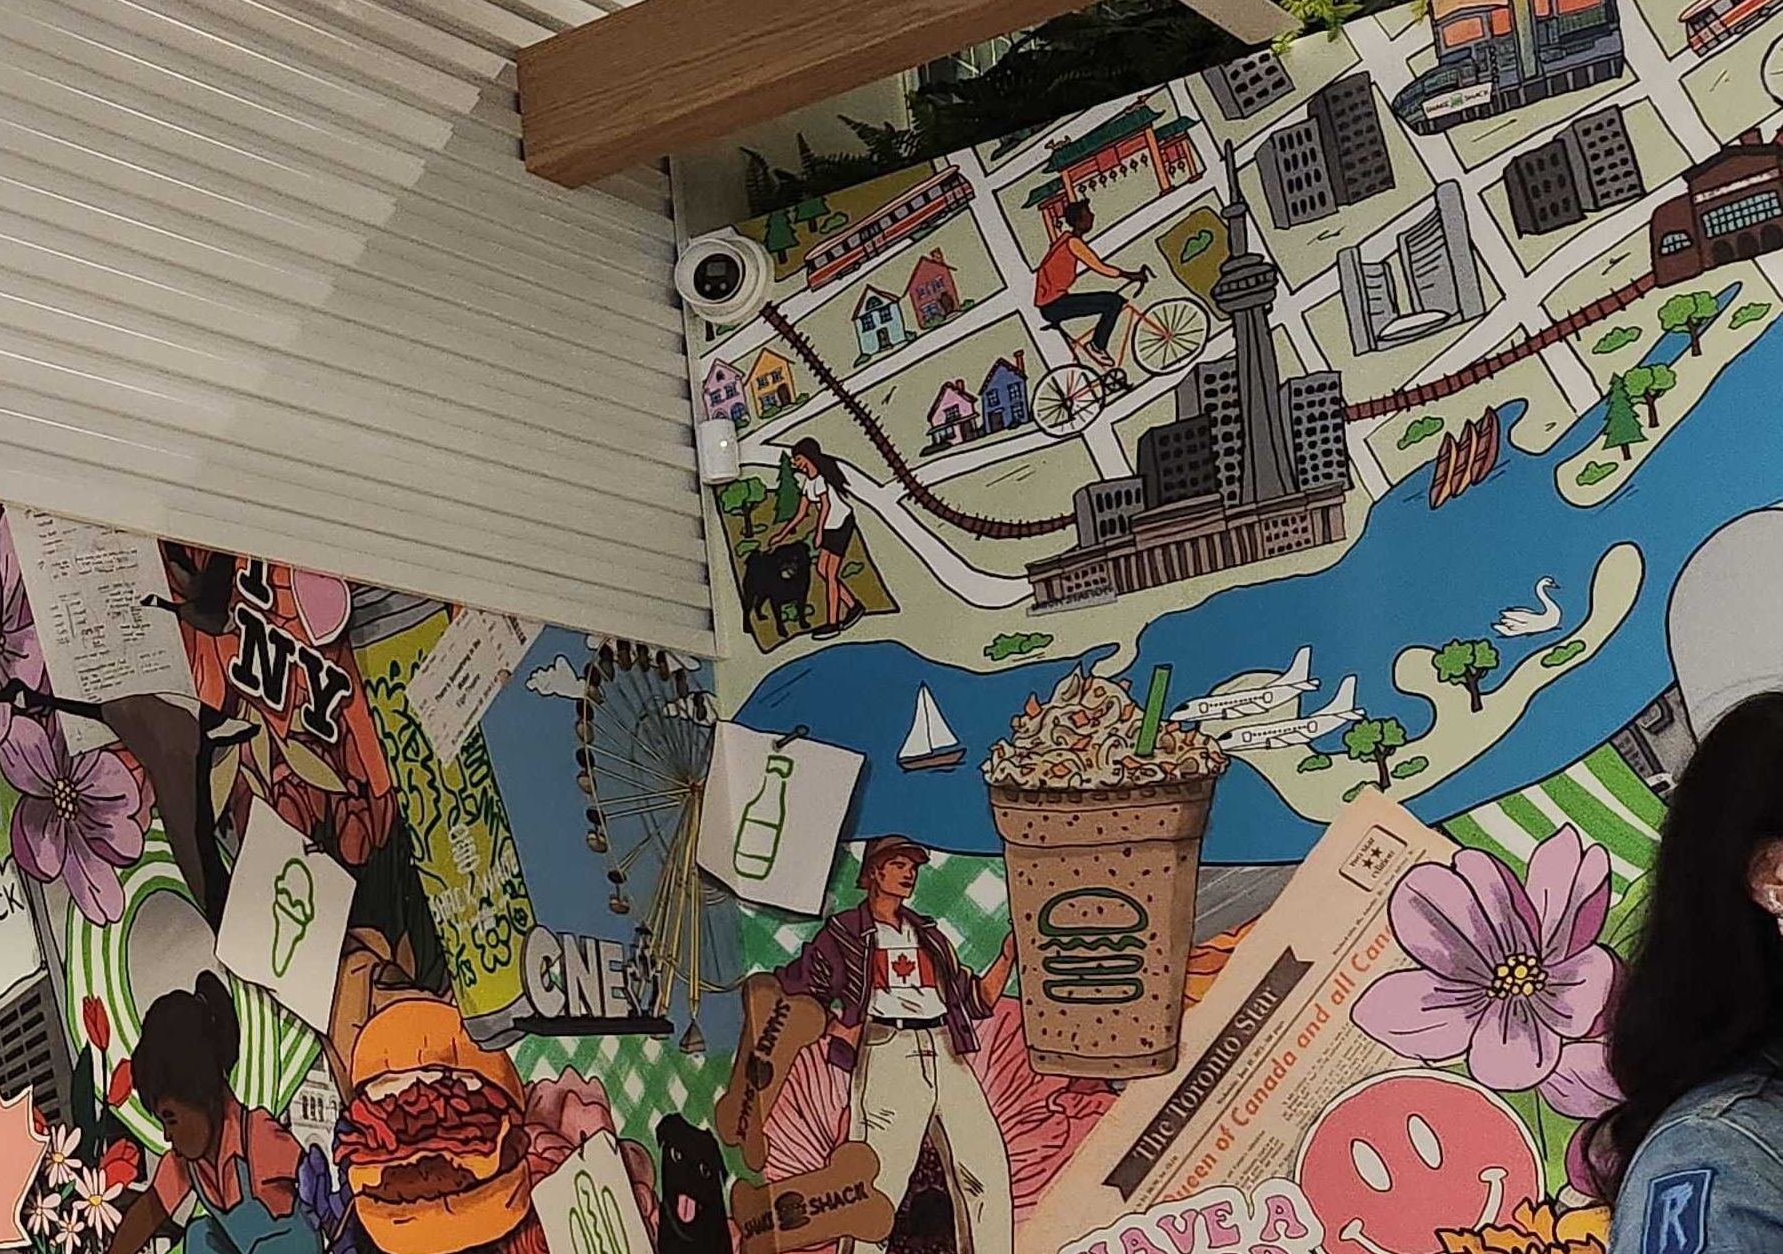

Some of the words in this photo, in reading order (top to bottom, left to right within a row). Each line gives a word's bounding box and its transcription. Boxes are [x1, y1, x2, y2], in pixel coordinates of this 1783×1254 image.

[231, 608, 352, 742] NY
[1131, 1114, 1176, 1164] The
[1167, 1034, 1242, 1124] Toronto
[1234, 984, 1282, 1036] Star
[1215, 1122, 1236, 1152] of
[1230, 1048, 1299, 1128] Canada
[1296, 1002, 1332, 1050] and
[1329, 969, 1357, 1008] all
[809, 1179, 869, 1217] SHACK
[1261, 1194, 1309, 1241] A
